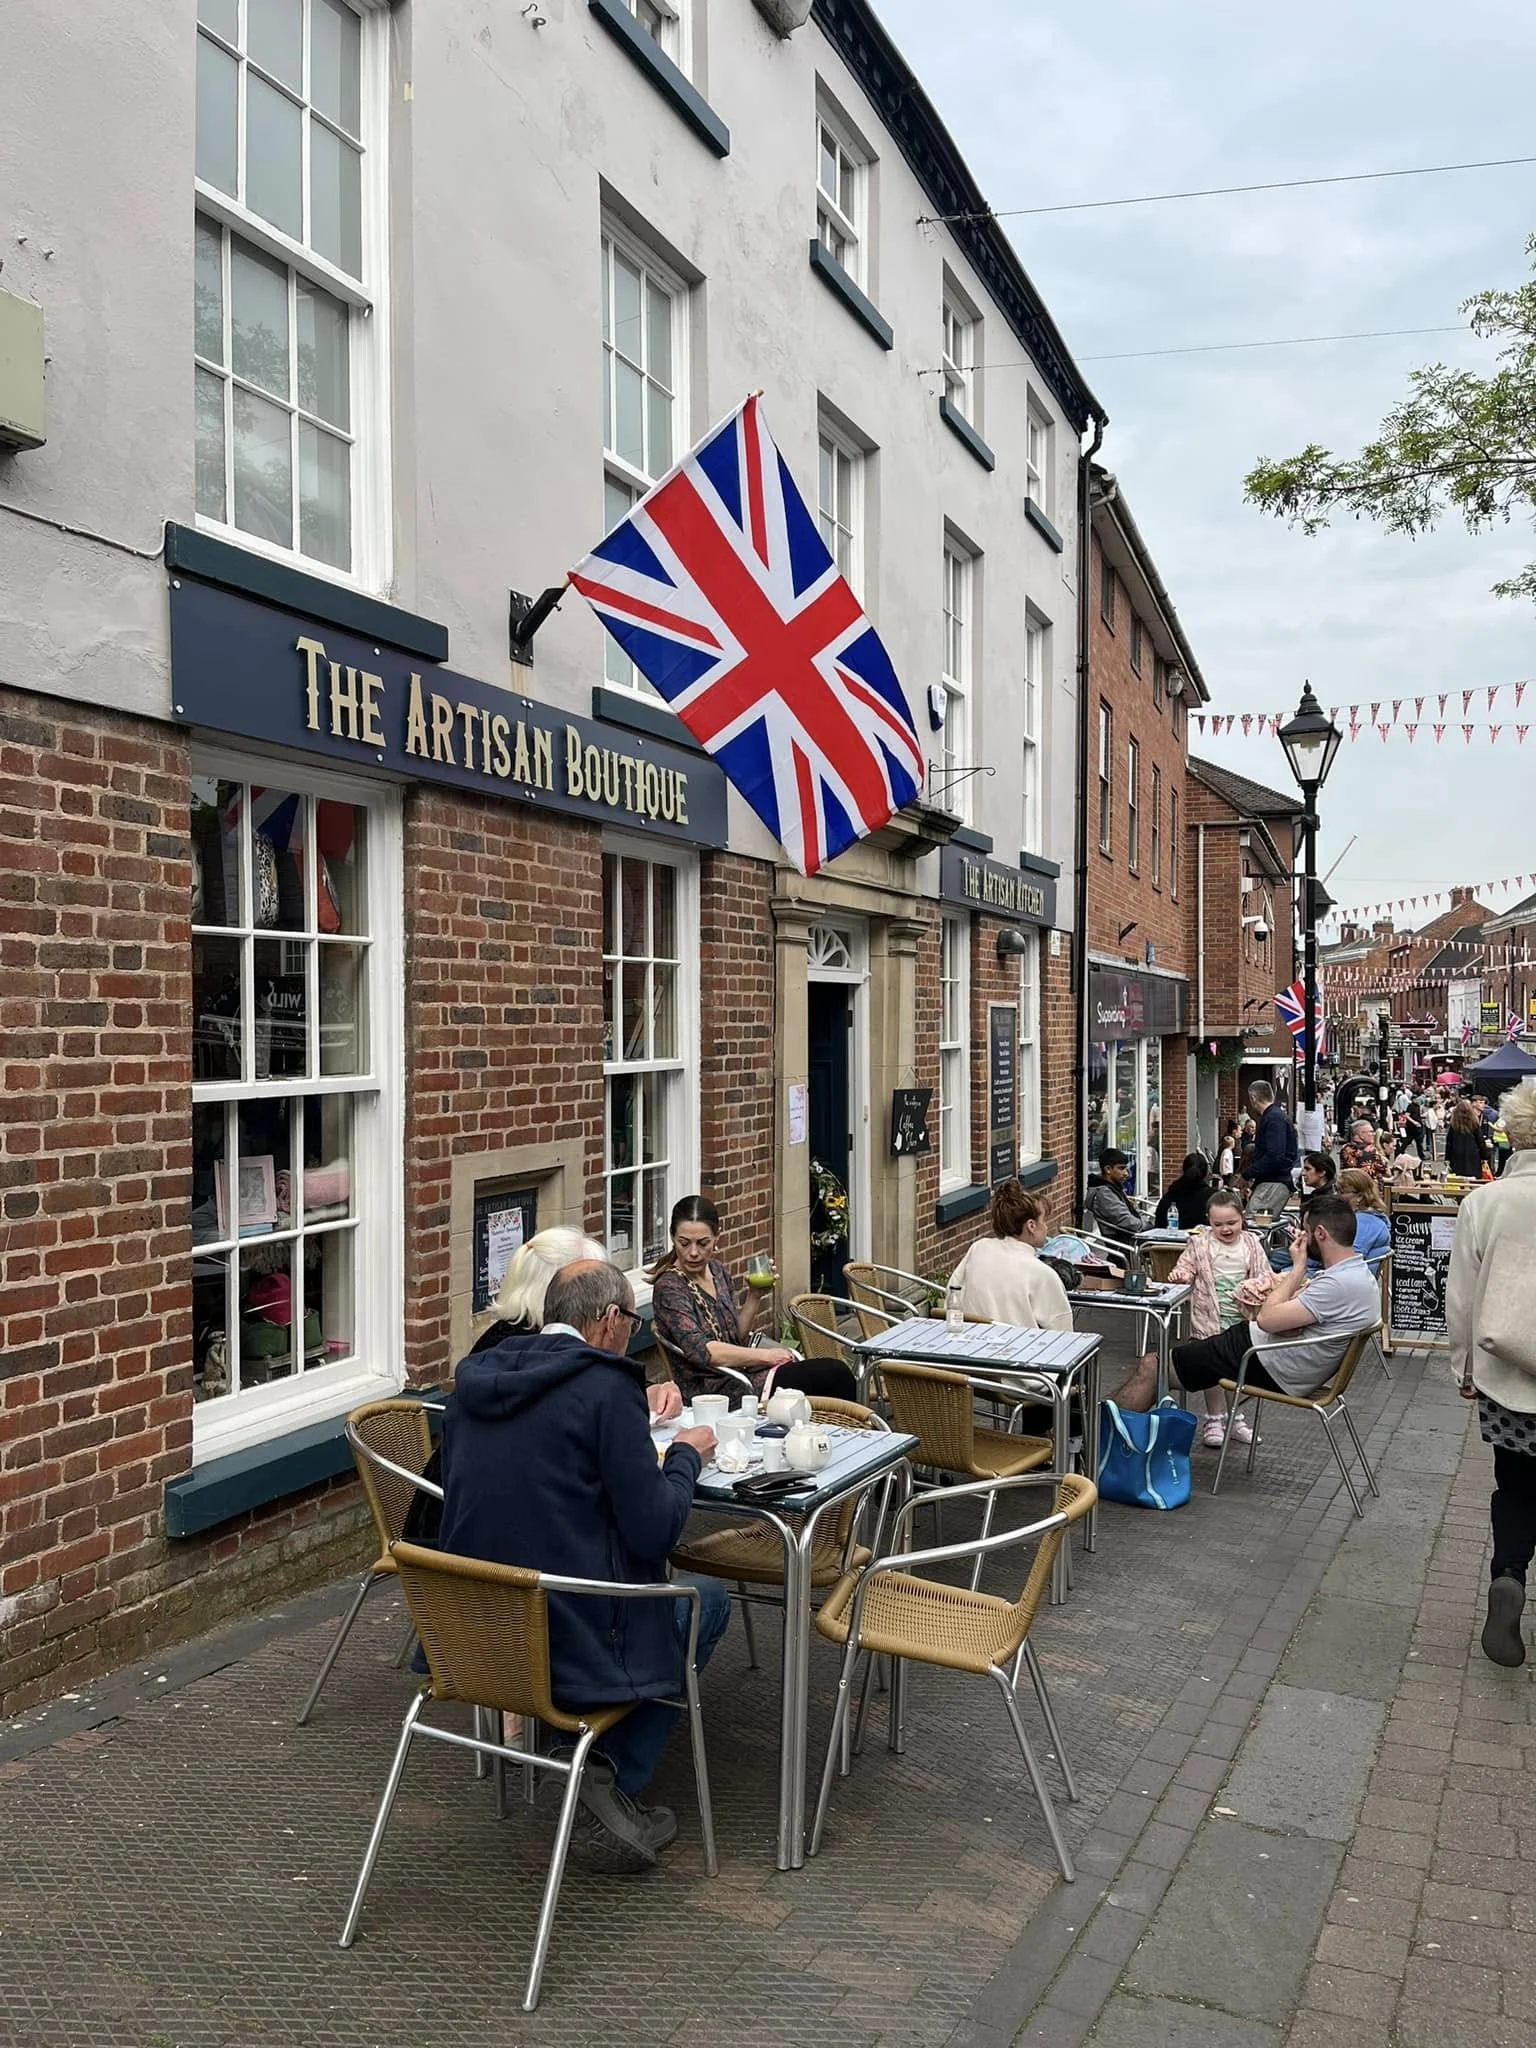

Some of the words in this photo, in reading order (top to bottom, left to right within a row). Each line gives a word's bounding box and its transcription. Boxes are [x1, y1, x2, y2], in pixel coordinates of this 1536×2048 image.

[296, 635, 386, 748] THE
[405, 671, 554, 791] ARTISAN
[565, 723, 690, 826] BOUTIQUE
[962, 856, 980, 899] THE
[983, 863, 1015, 909] ARTISAN
[1016, 875, 1044, 917] KITCHEN
